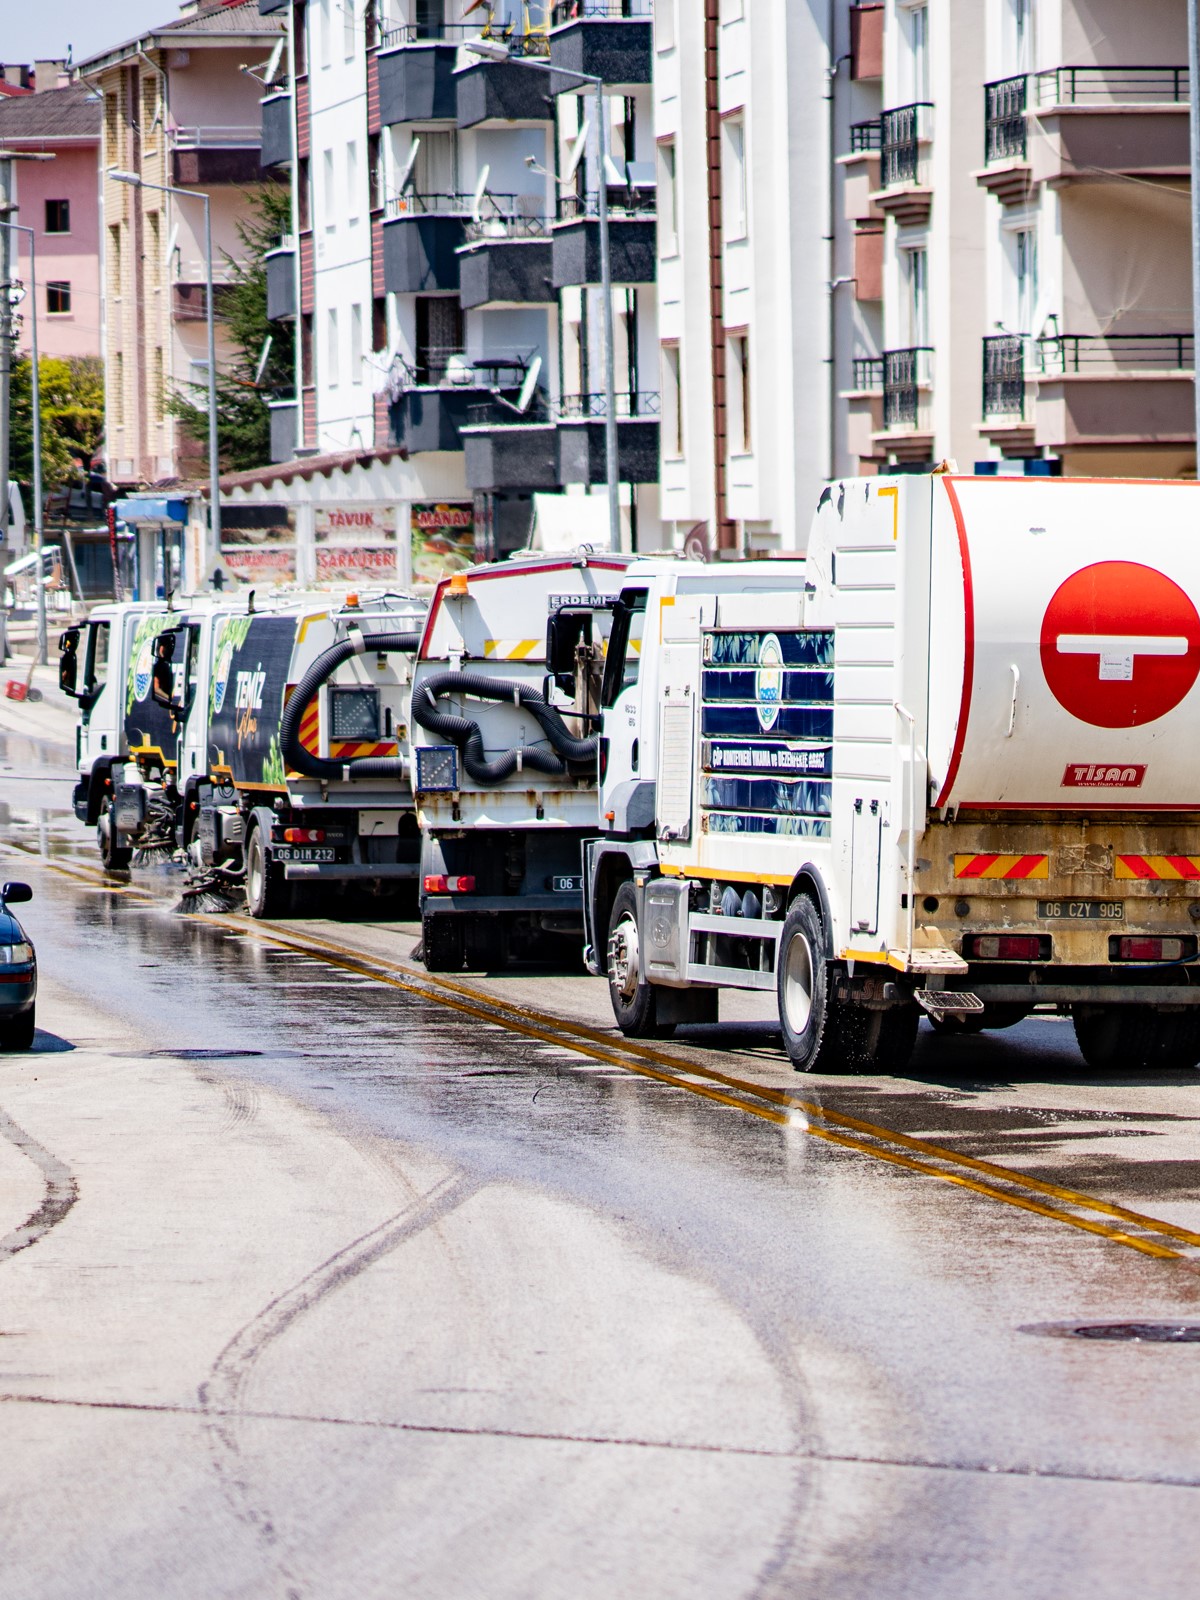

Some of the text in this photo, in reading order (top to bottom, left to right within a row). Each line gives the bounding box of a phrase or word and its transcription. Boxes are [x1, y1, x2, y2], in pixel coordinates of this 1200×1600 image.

[328, 511, 374, 527] TAVUK
[417, 510, 471, 528] MANAV
[1074, 765, 1137, 782] TİSAN
[278, 849, 290, 859] 06
[315, 849, 333, 860] 212
[560, 878, 573, 889] 06
[1046, 903, 1122, 918] 06 CZY 905
